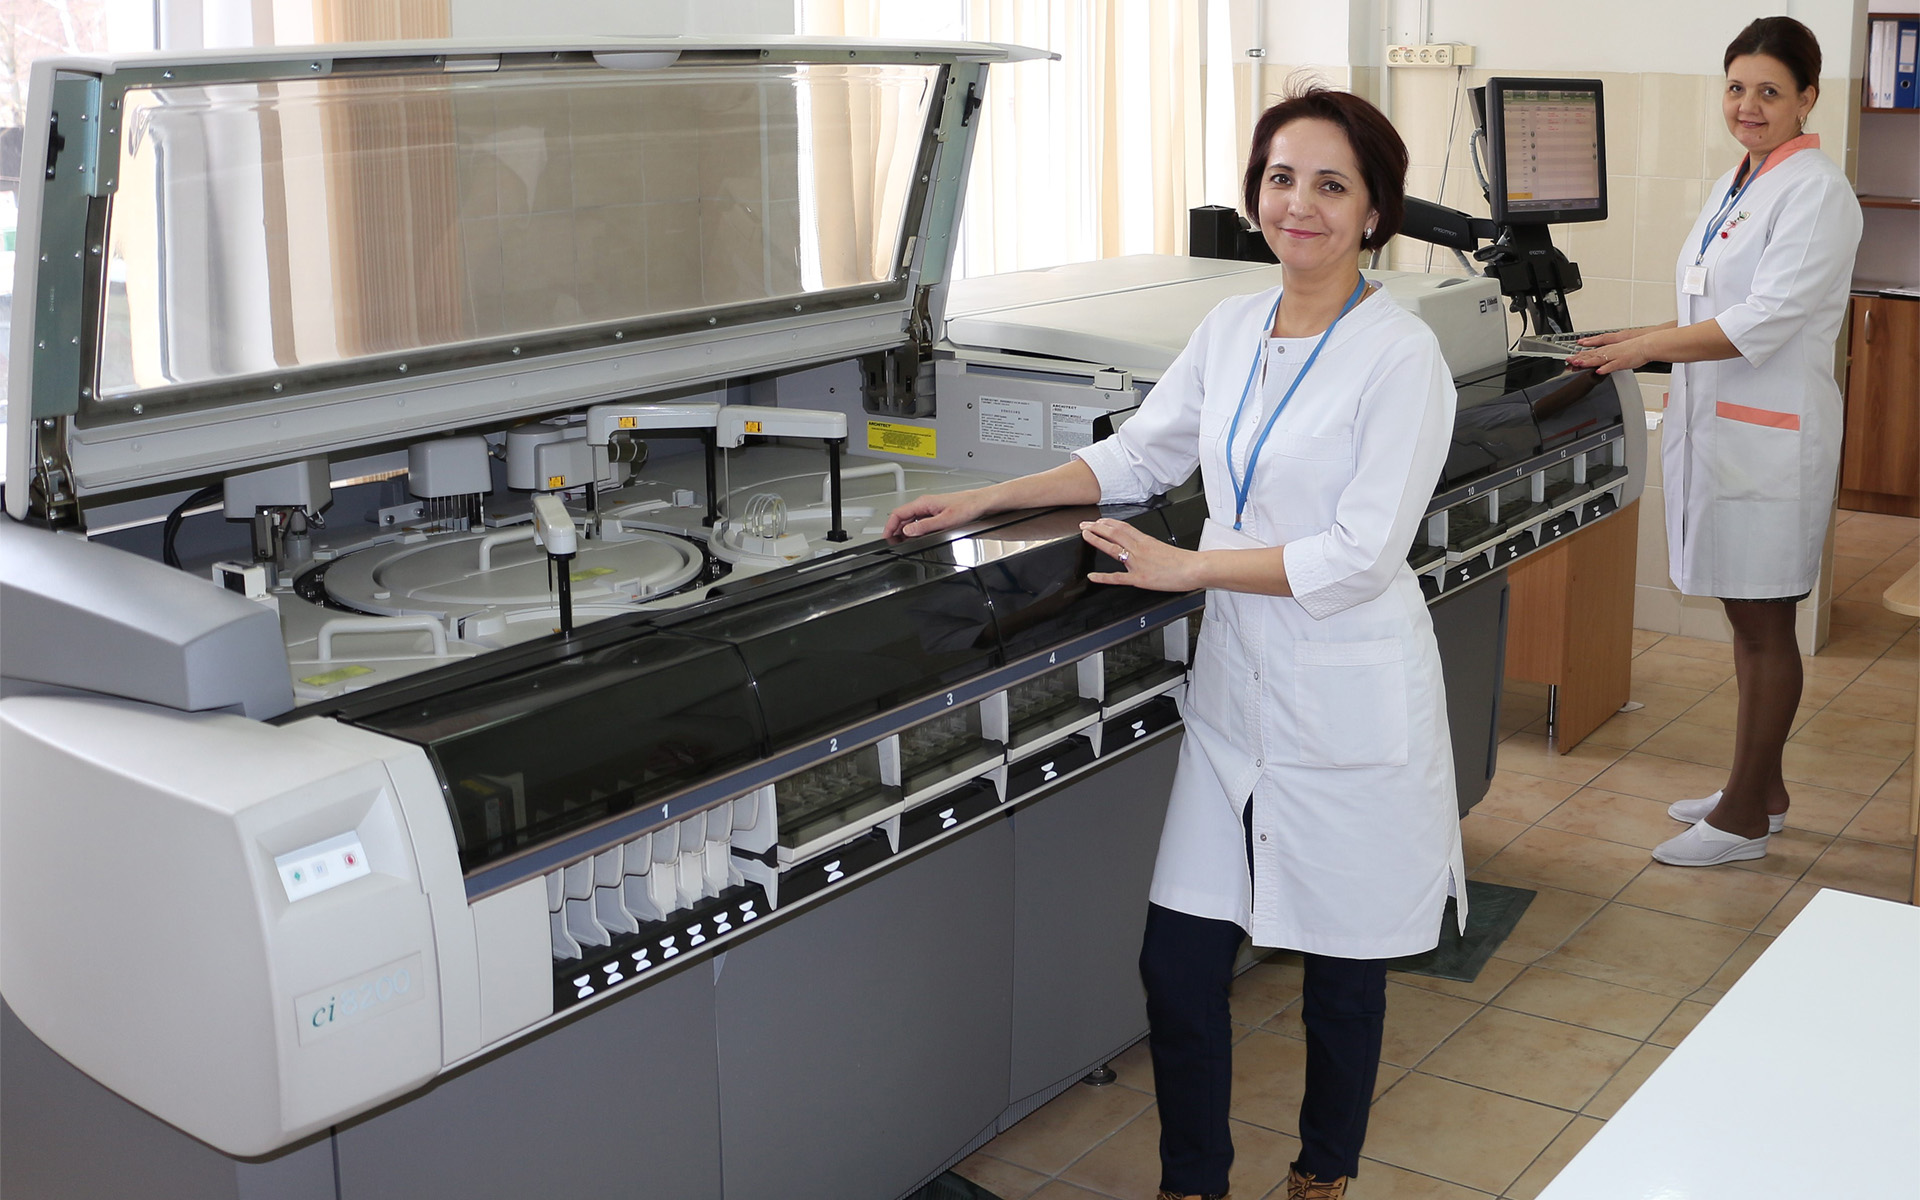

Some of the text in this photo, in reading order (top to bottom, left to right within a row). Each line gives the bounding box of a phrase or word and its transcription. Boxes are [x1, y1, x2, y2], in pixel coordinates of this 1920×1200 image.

[1601, 433, 1607, 441] 13
[1560, 450, 1566, 458] 12
[1516, 467, 1522, 476] 11
[1468, 486, 1475, 496] 10
[1140, 616, 1146, 628] 5
[1049, 652, 1056, 664] 4
[946, 693, 954, 706] 3
[830, 738, 838, 752] 2
[661, 803, 669, 819] 1
